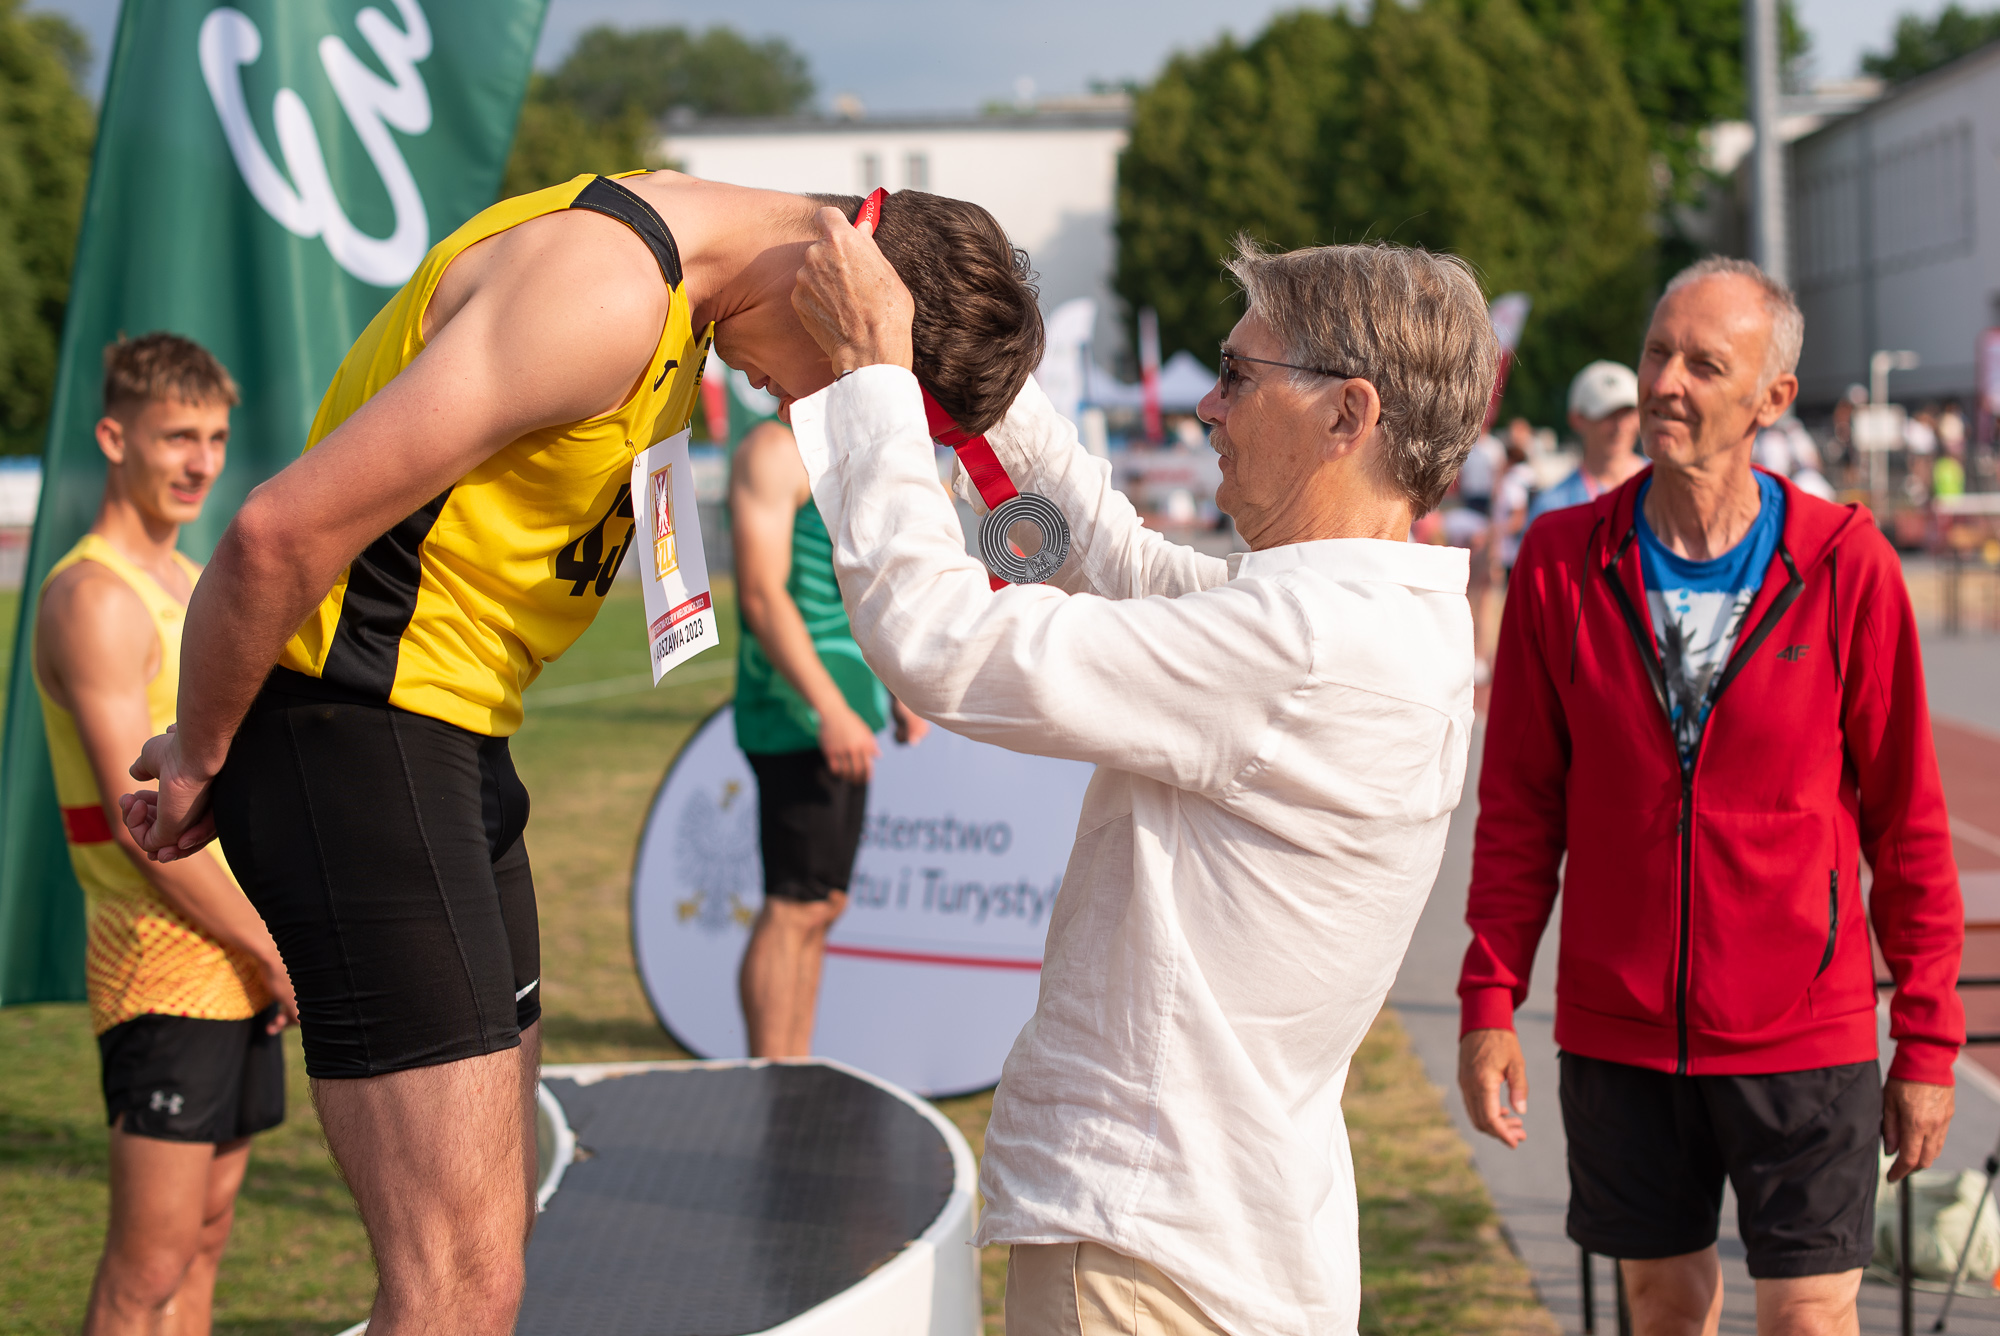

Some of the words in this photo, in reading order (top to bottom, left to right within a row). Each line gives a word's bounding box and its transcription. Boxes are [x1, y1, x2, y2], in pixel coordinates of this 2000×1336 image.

[685, 617, 704, 643] 2023
[1776, 644, 1810, 662] 4F
[862, 811, 1013, 856] sterstwo
